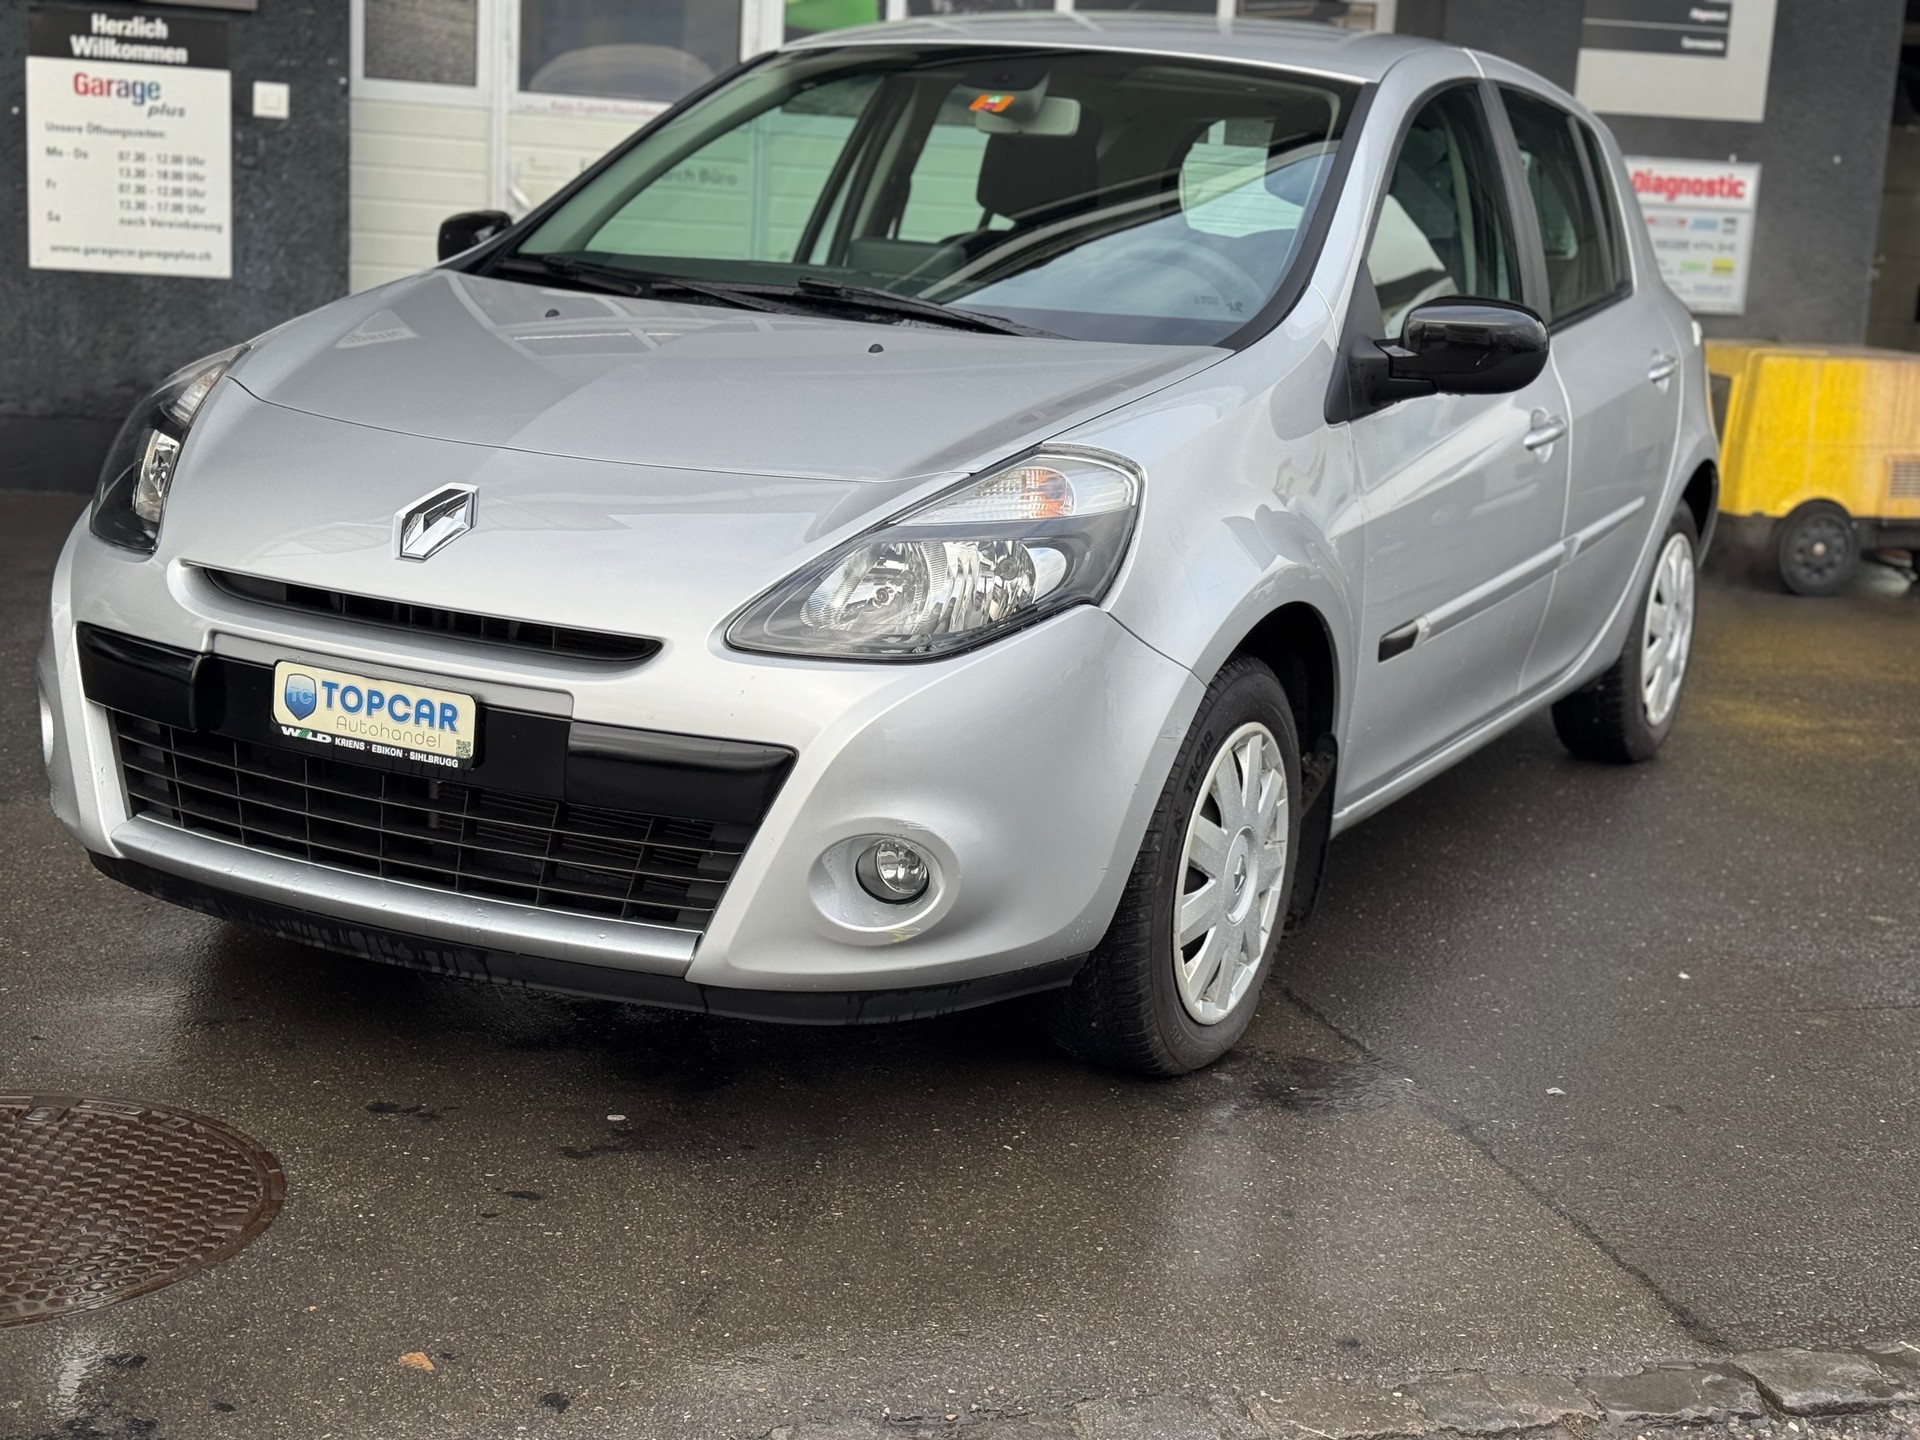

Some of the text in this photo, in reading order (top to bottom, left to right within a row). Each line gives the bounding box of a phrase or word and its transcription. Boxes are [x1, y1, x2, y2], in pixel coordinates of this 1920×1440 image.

[91, 13, 168, 39] Herzlich
[70, 35, 188, 64] Willkommen
[73, 72, 161, 105] Garage
[147, 104, 186, 119] plus
[1632, 168, 1746, 202] Diagnostic
[321, 680, 458, 732] TOPCAR
[336, 715, 441, 748] Autohandel
[335, 737, 365, 751] KRIENS
[371, 744, 403, 758] EBIKON
[409, 751, 459, 768] SIHLBRUGG
